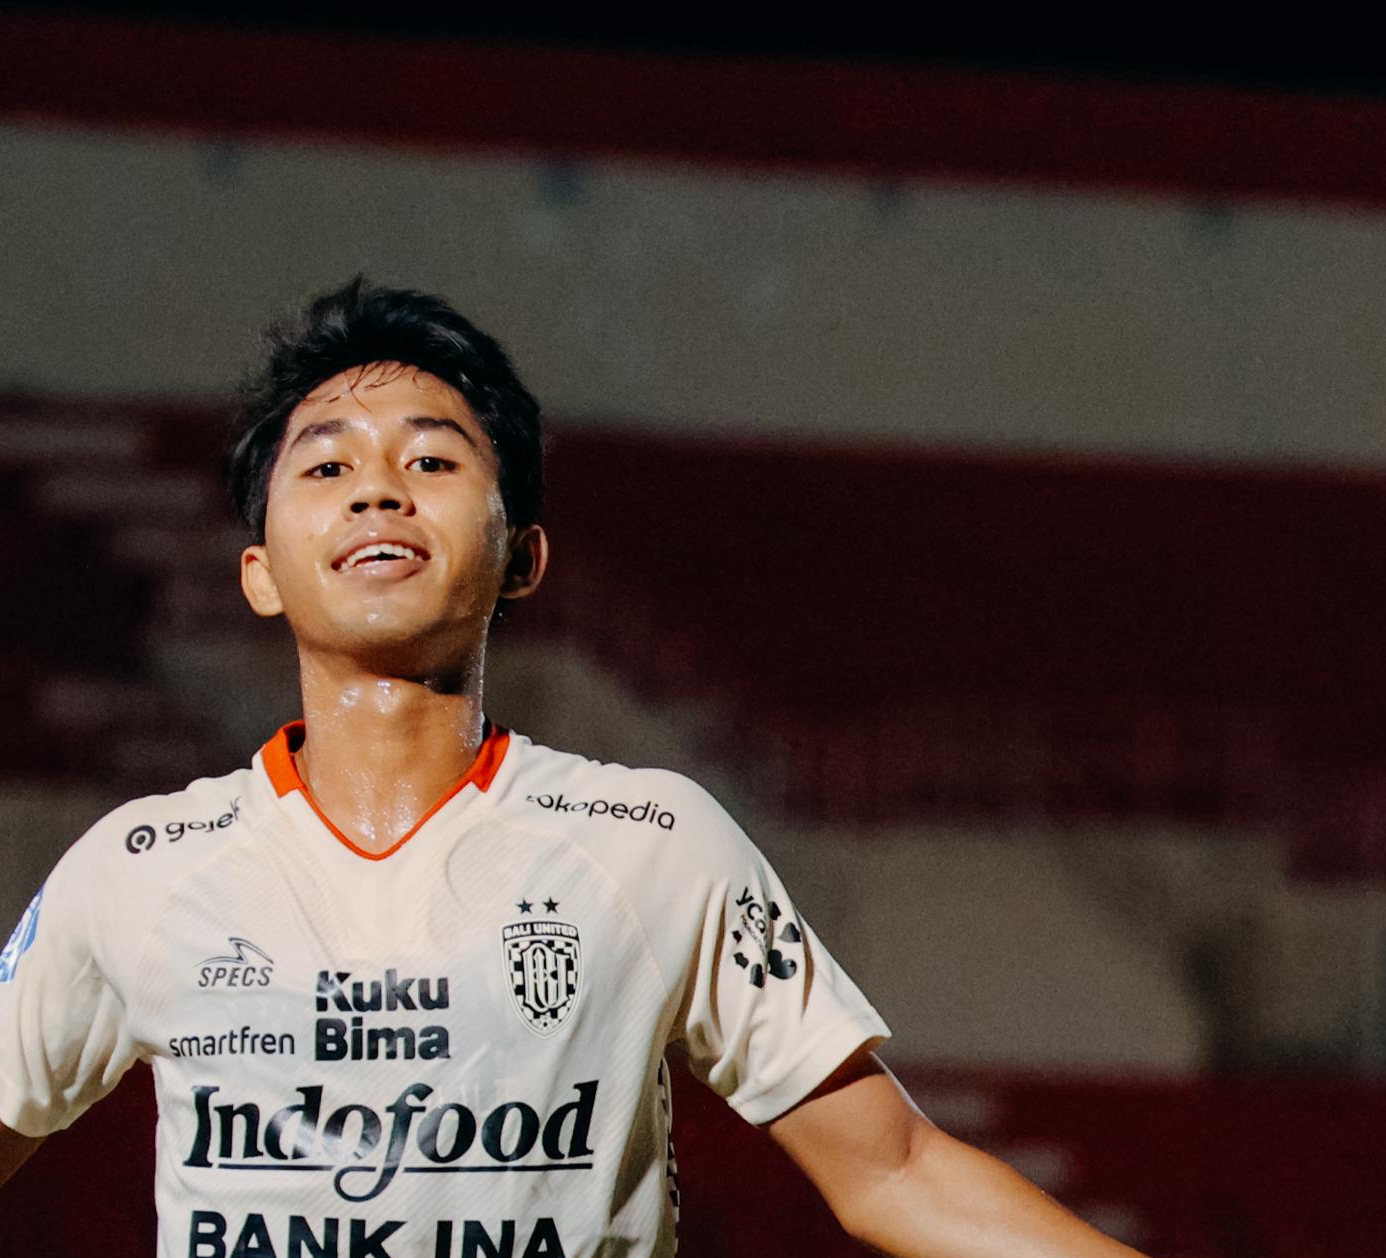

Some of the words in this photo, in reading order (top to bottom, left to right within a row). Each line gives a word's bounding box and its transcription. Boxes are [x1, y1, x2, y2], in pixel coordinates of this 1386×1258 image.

[503, 923, 532, 940] BALI
[532, 921, 578, 939] UNITED
[198, 966, 274, 988] SPECS
[315, 968, 451, 1012] Kuku
[168, 1025, 296, 1058] smartfren
[314, 1016, 452, 1062] Bima
[182, 1079, 600, 1203] Indofood
